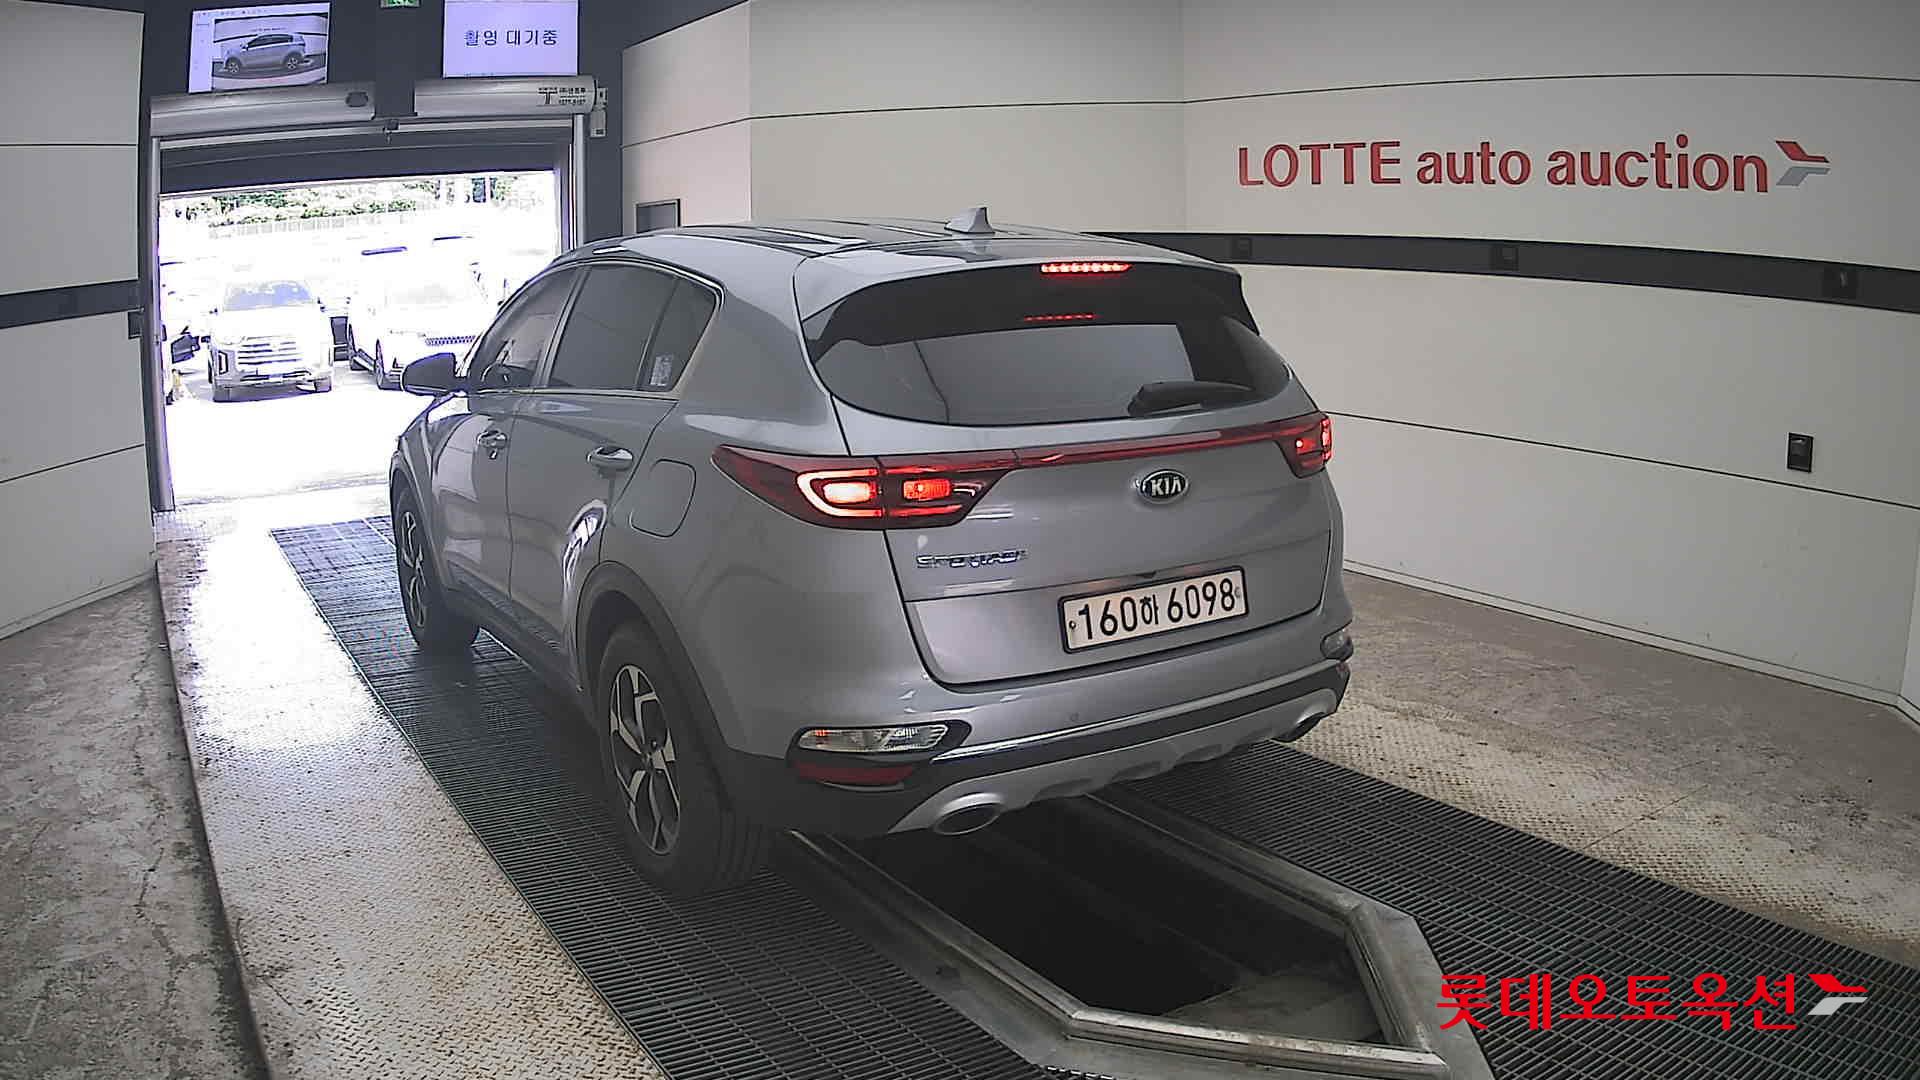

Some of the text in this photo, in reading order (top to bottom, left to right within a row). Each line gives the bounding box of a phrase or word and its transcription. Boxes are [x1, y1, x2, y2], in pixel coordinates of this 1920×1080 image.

[506, 29, 558, 46] 대기중
[1239, 134, 1770, 192] LOTTE auto auction
[1150, 475, 1183, 497] KIA
[1078, 578, 1236, 640] 160하 6098
